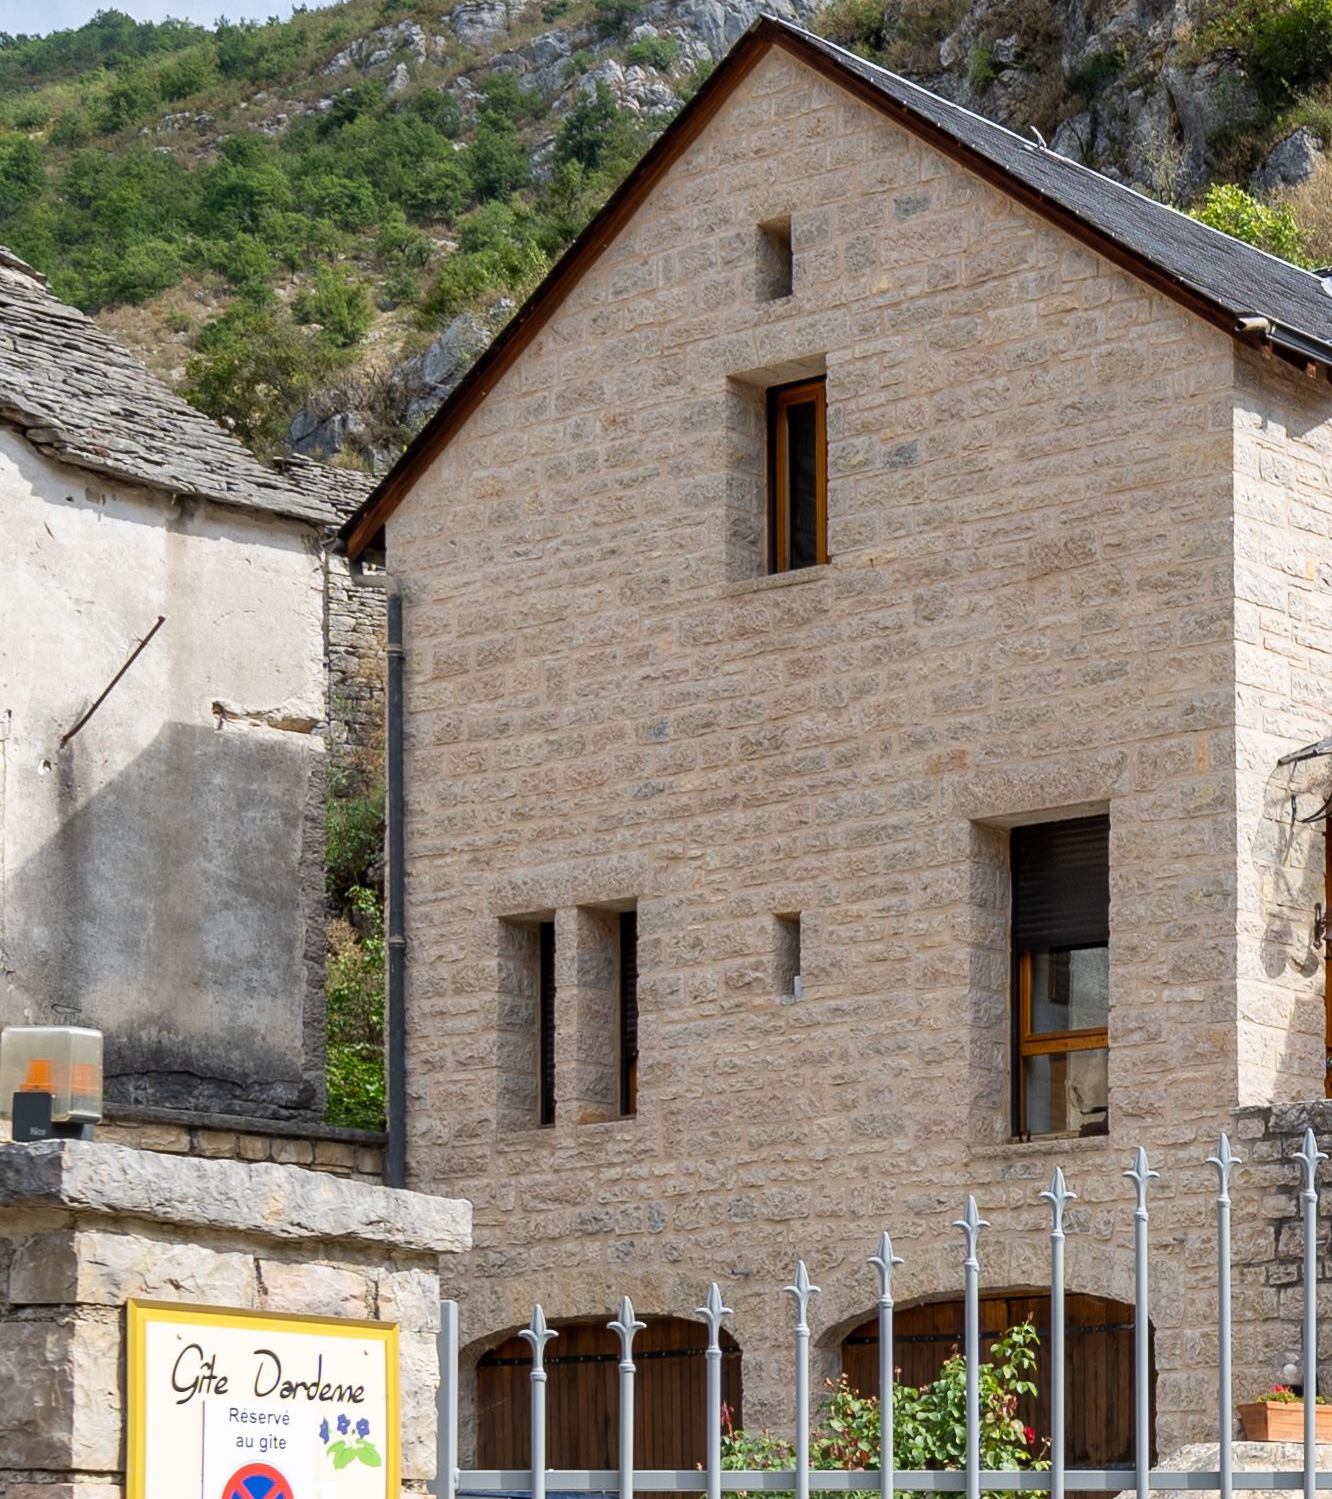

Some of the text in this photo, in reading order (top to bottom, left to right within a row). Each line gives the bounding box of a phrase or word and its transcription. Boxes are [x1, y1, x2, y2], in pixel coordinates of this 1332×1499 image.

[171, 1343, 228, 1405] Gîte
[229, 1407, 290, 1426] Réservé
[236, 1433, 287, 1453] au gîte
